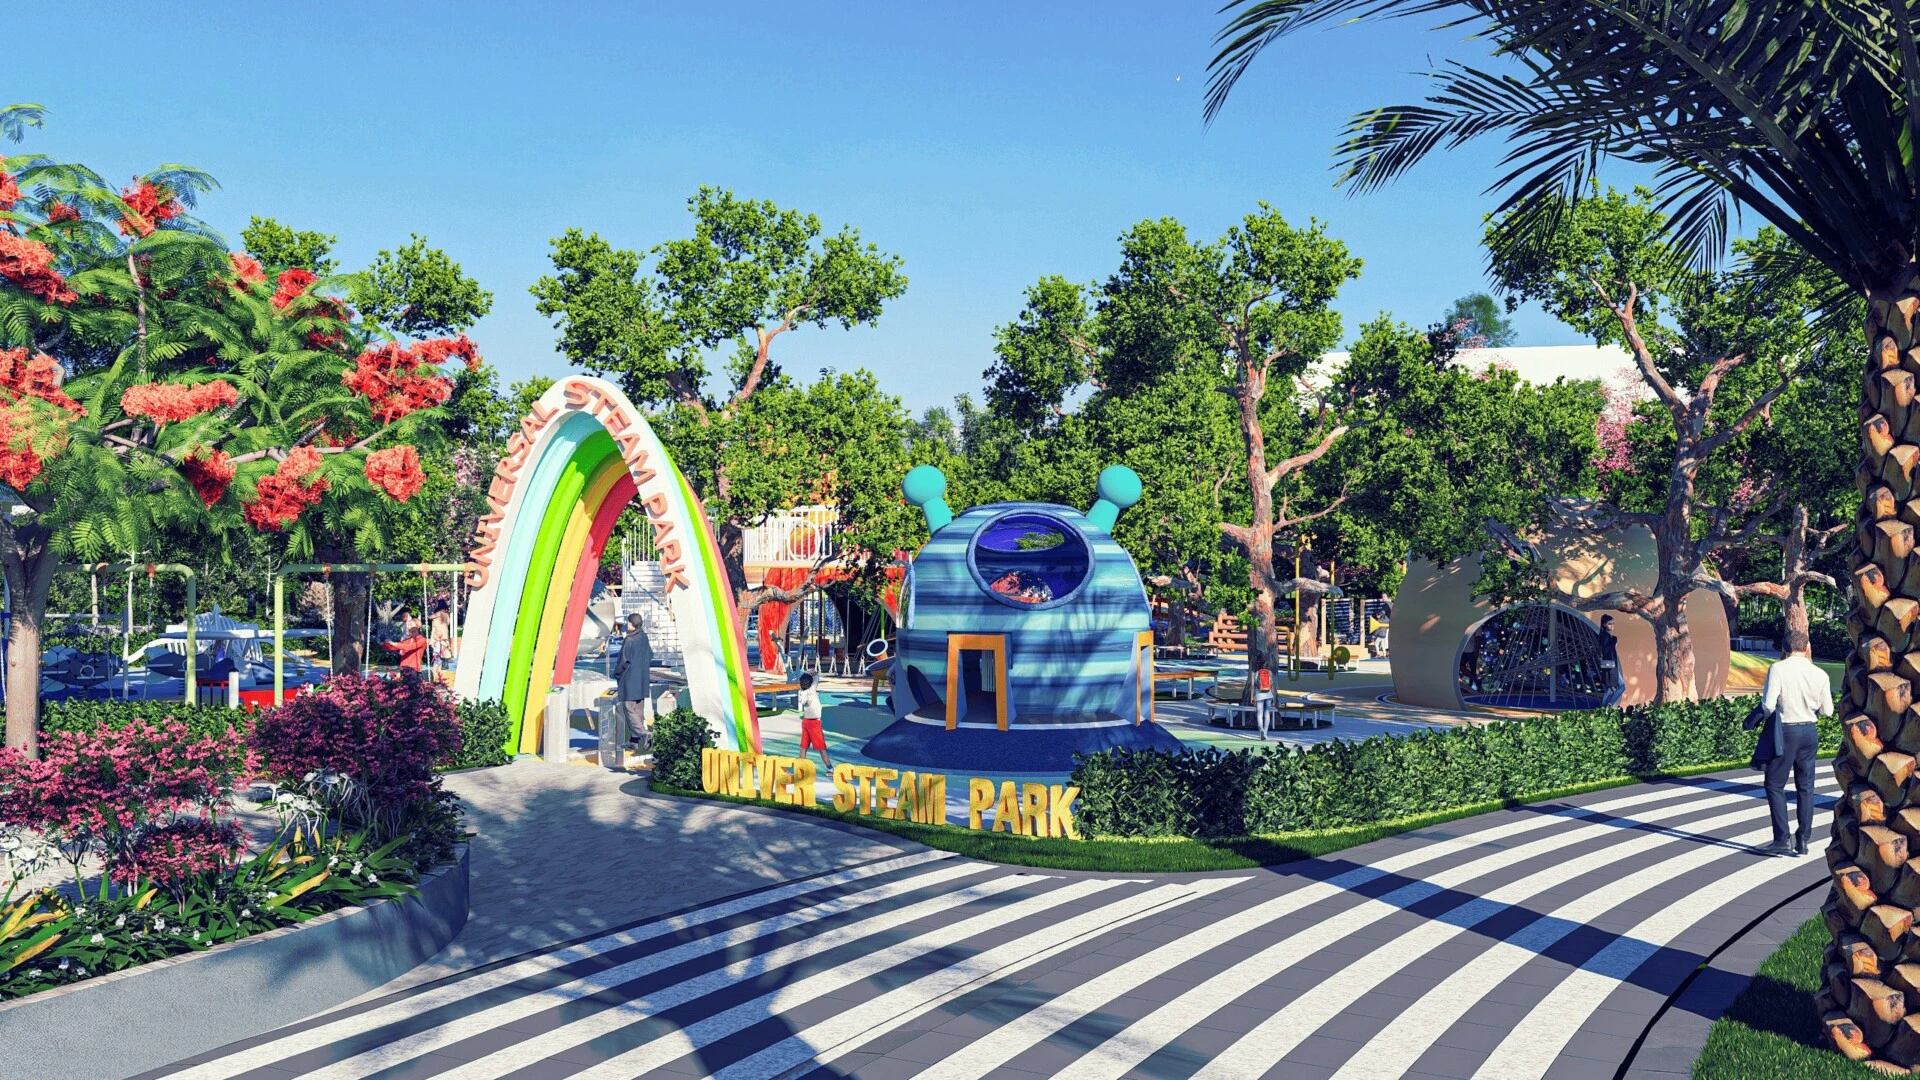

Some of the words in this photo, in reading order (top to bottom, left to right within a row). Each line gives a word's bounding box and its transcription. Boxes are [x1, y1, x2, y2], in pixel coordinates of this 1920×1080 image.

[464, 401, 559, 588] UNIVERSAL
[564, 380, 656, 486] STEAM
[641, 492, 689, 593] PARK
[701, 747, 817, 807] UNIVER
[832, 762, 946, 826] STEAM
[969, 777, 1082, 841] PARK
